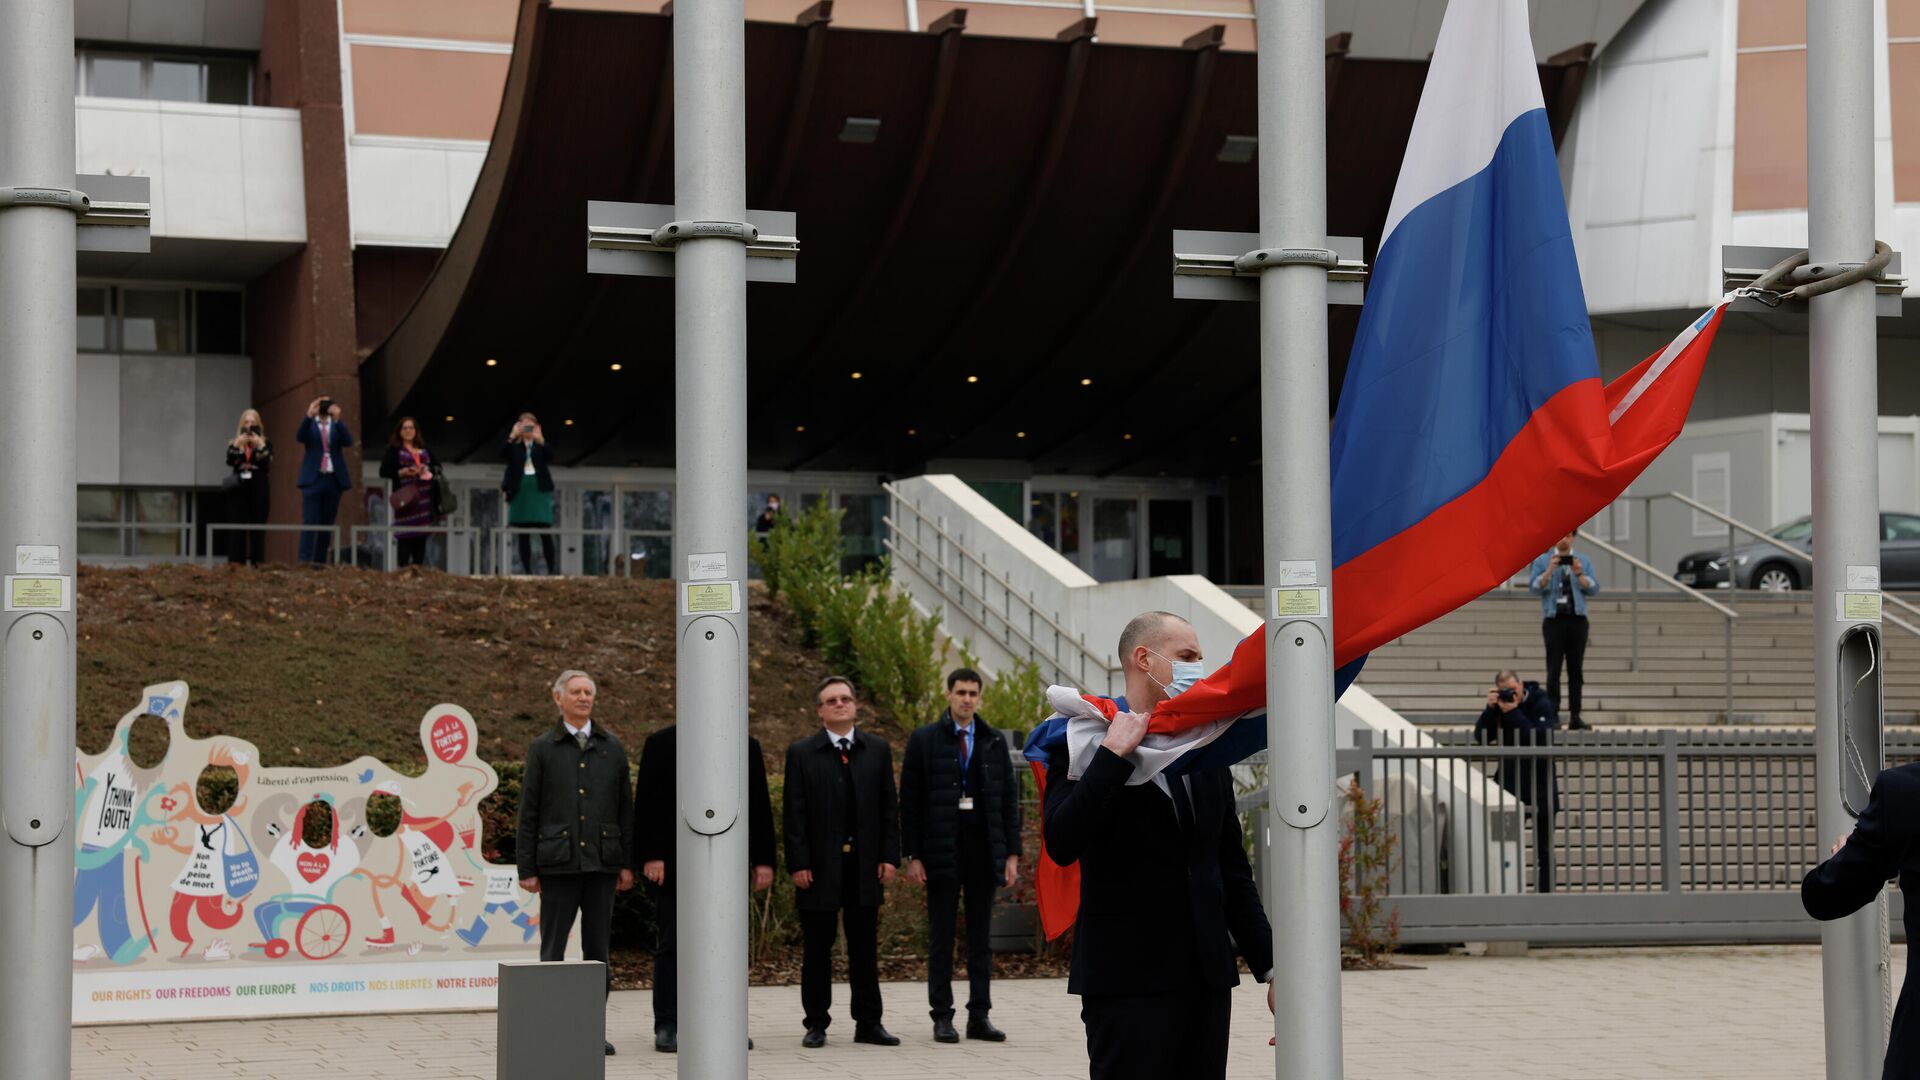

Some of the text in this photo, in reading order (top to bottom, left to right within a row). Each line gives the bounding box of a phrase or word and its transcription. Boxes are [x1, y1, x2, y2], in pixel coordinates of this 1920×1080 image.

[695, 225, 733, 233] SIGNATURE
[435, 730, 465, 750] TORTURE
[257, 776, 290, 786] Liberté
[108, 787, 135, 808] THINK
[196, 852, 210, 861] Non
[413, 850, 440, 869] TORTURE
[187, 871, 211, 880] peine
[180, 878, 214, 889] de mort
[310, 982, 329, 993] NOS
[331, 980, 366, 992] DROITS
[368, 980, 388, 991] NOS
[436, 977, 467, 989] NOTRE
[92, 983, 297, 1002] OUR RIGHTS OUR FREEDOMS OUR EUROPE
